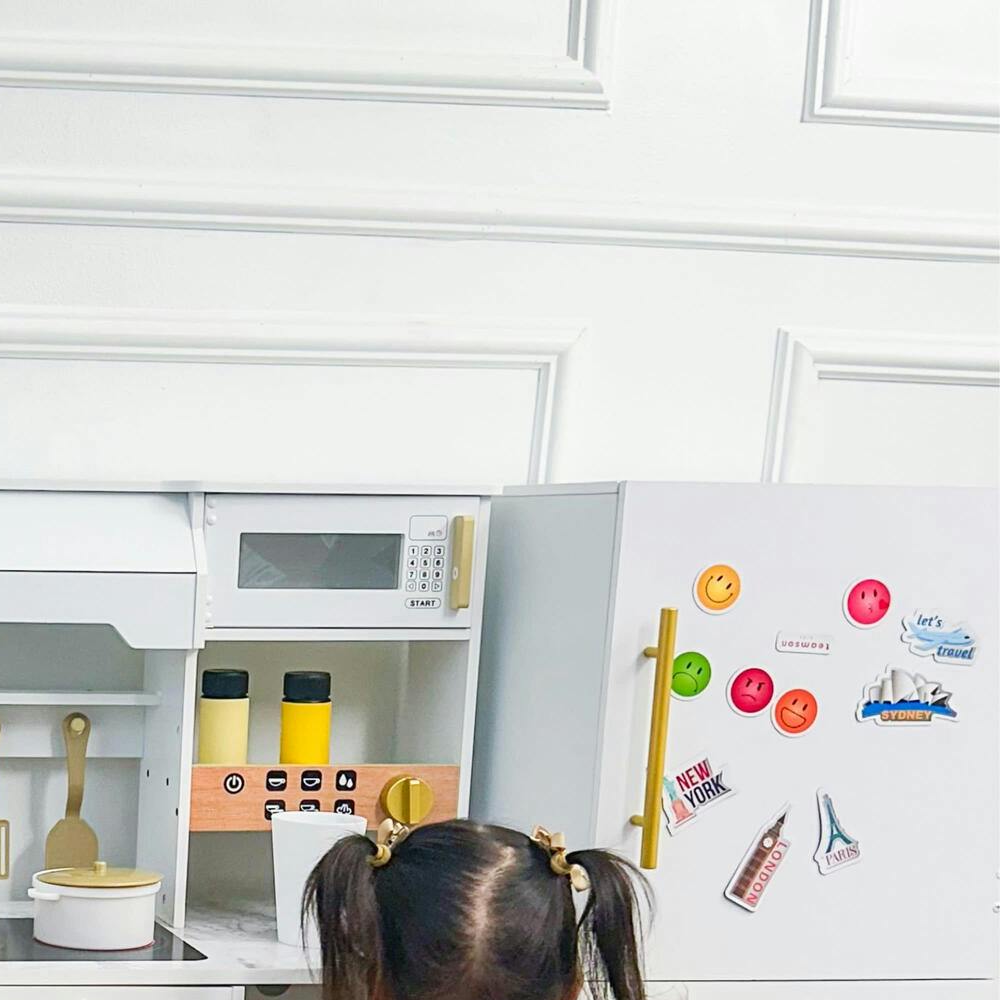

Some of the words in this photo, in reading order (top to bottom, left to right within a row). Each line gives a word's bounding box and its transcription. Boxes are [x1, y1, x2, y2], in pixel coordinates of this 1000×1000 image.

[917, 614, 943, 628] let's
[936, 645, 975, 660] travel
[881, 710, 932, 720] SYDNEY
[676, 760, 710, 792] NEW
[683, 773, 727, 808] YORK
[825, 844, 858, 866] PARIS
[746, 841, 788, 904] LONDON
